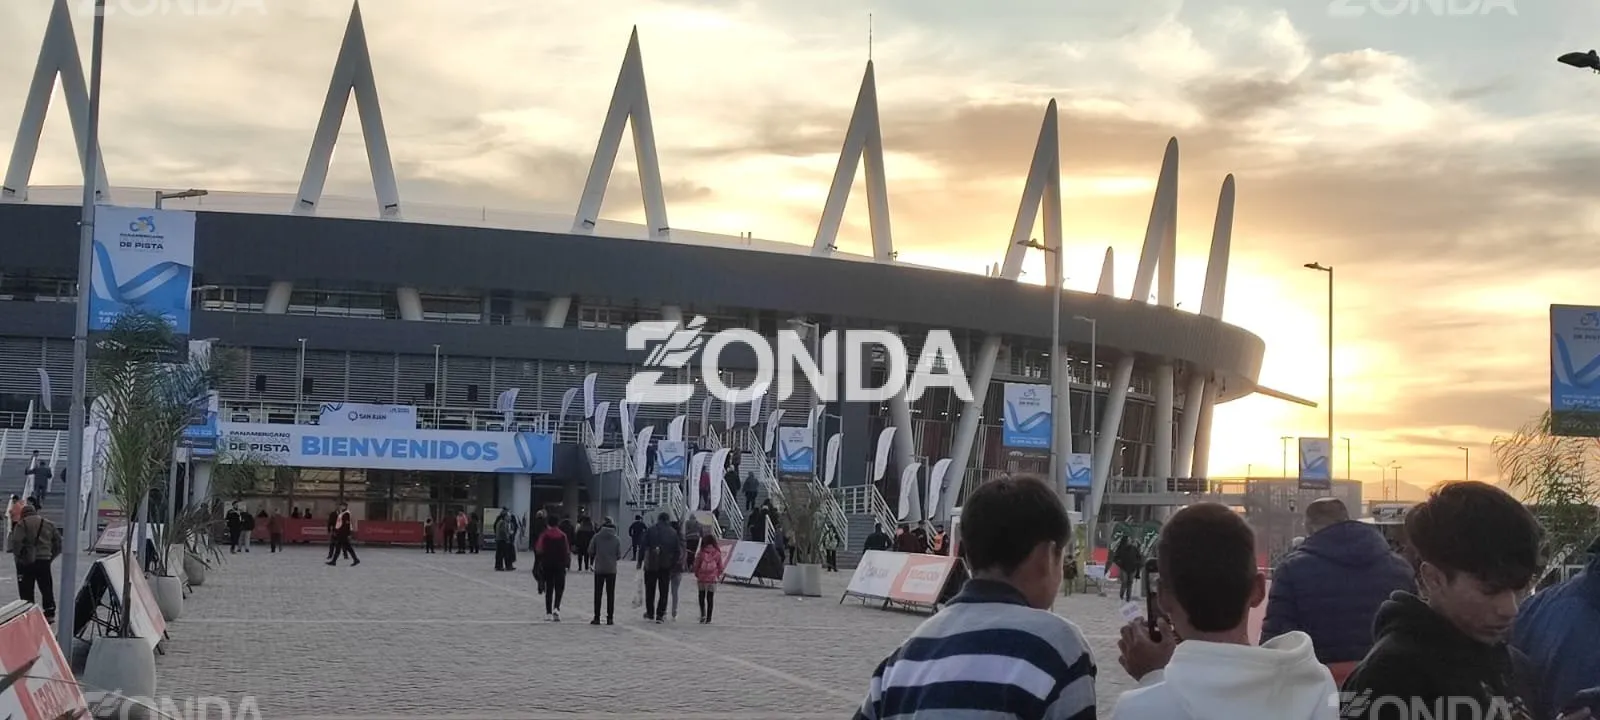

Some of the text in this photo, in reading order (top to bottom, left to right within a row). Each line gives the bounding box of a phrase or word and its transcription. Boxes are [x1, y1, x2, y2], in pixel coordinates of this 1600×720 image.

[134, 242, 164, 250] PISTA
[229, 430, 291, 438] PANAMERICANO
[229, 443, 290, 452] DE PISTA
[301, 436, 499, 461] BIENVENIDOS
